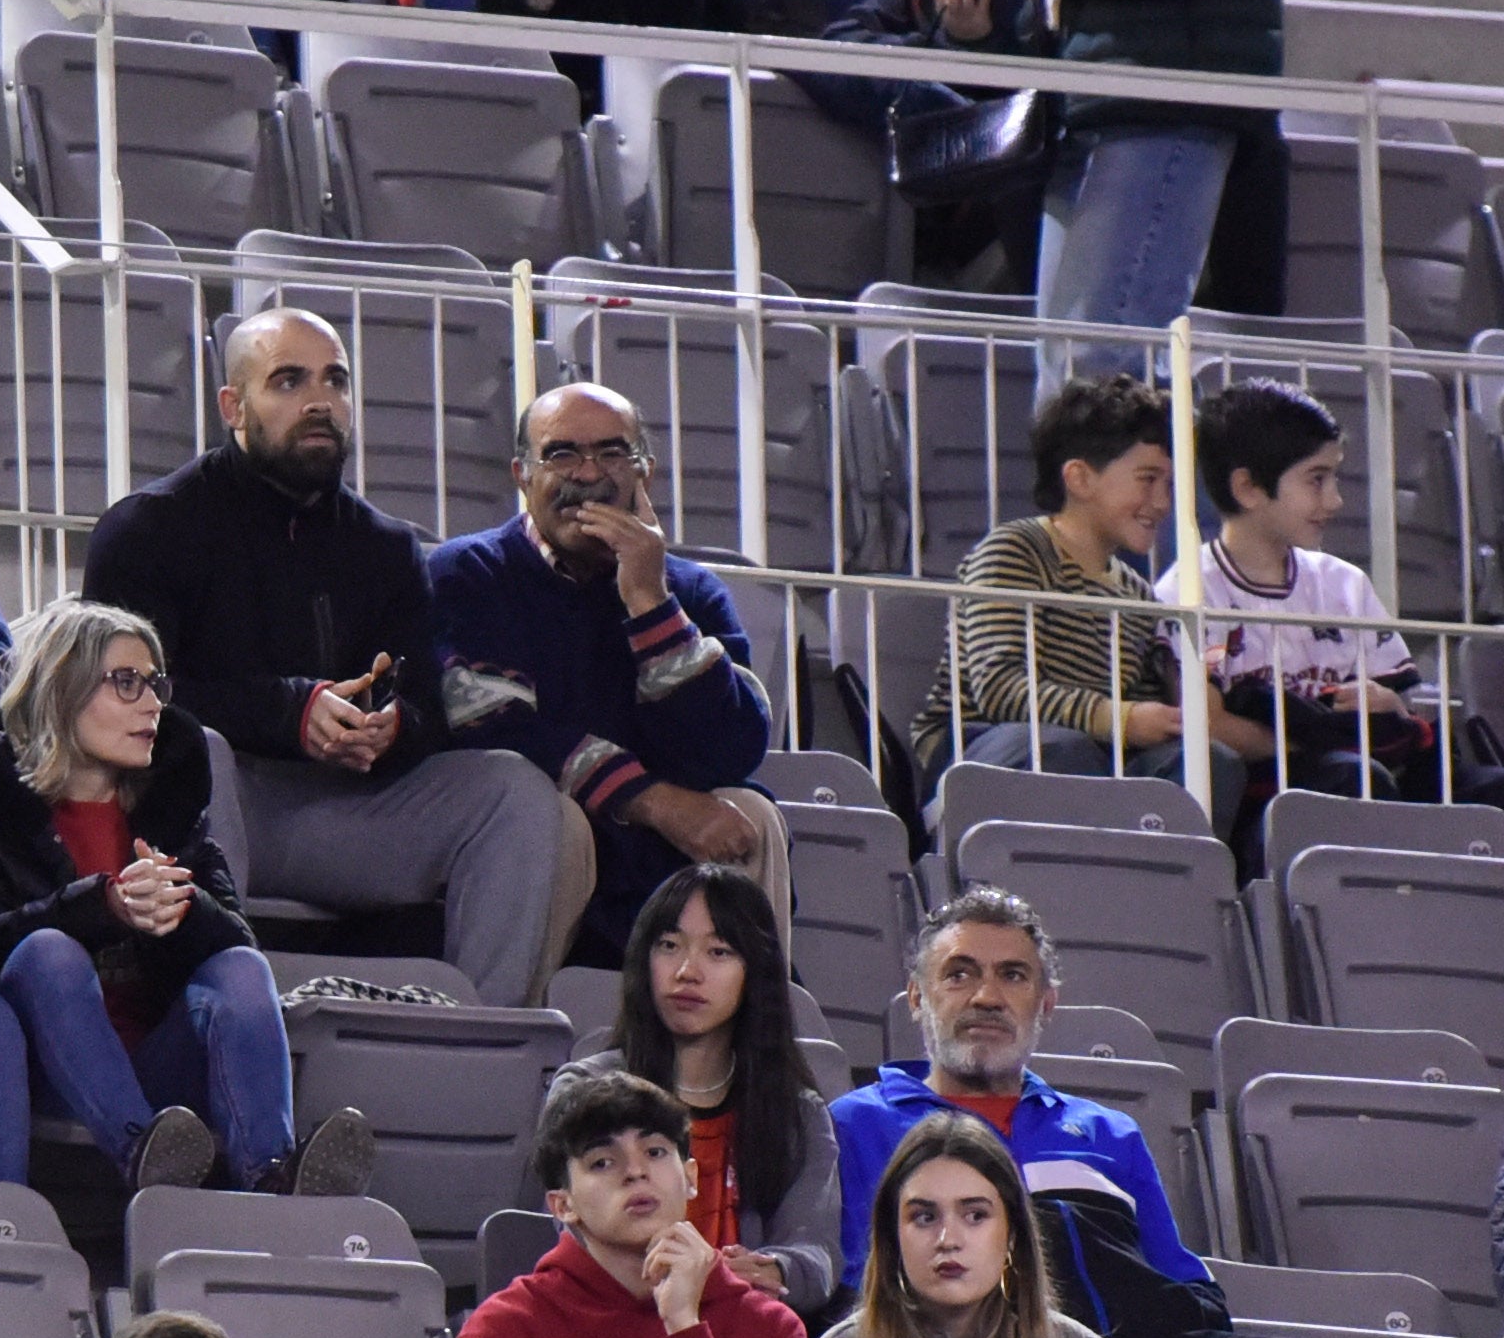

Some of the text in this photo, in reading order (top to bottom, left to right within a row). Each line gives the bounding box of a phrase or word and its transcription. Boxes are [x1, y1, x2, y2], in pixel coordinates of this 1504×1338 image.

[816, 793, 833, 803] 80
[1145, 820, 1161, 829] 82
[350, 1242, 366, 1252] 74
[1390, 1318, 1407, 1328] 80
